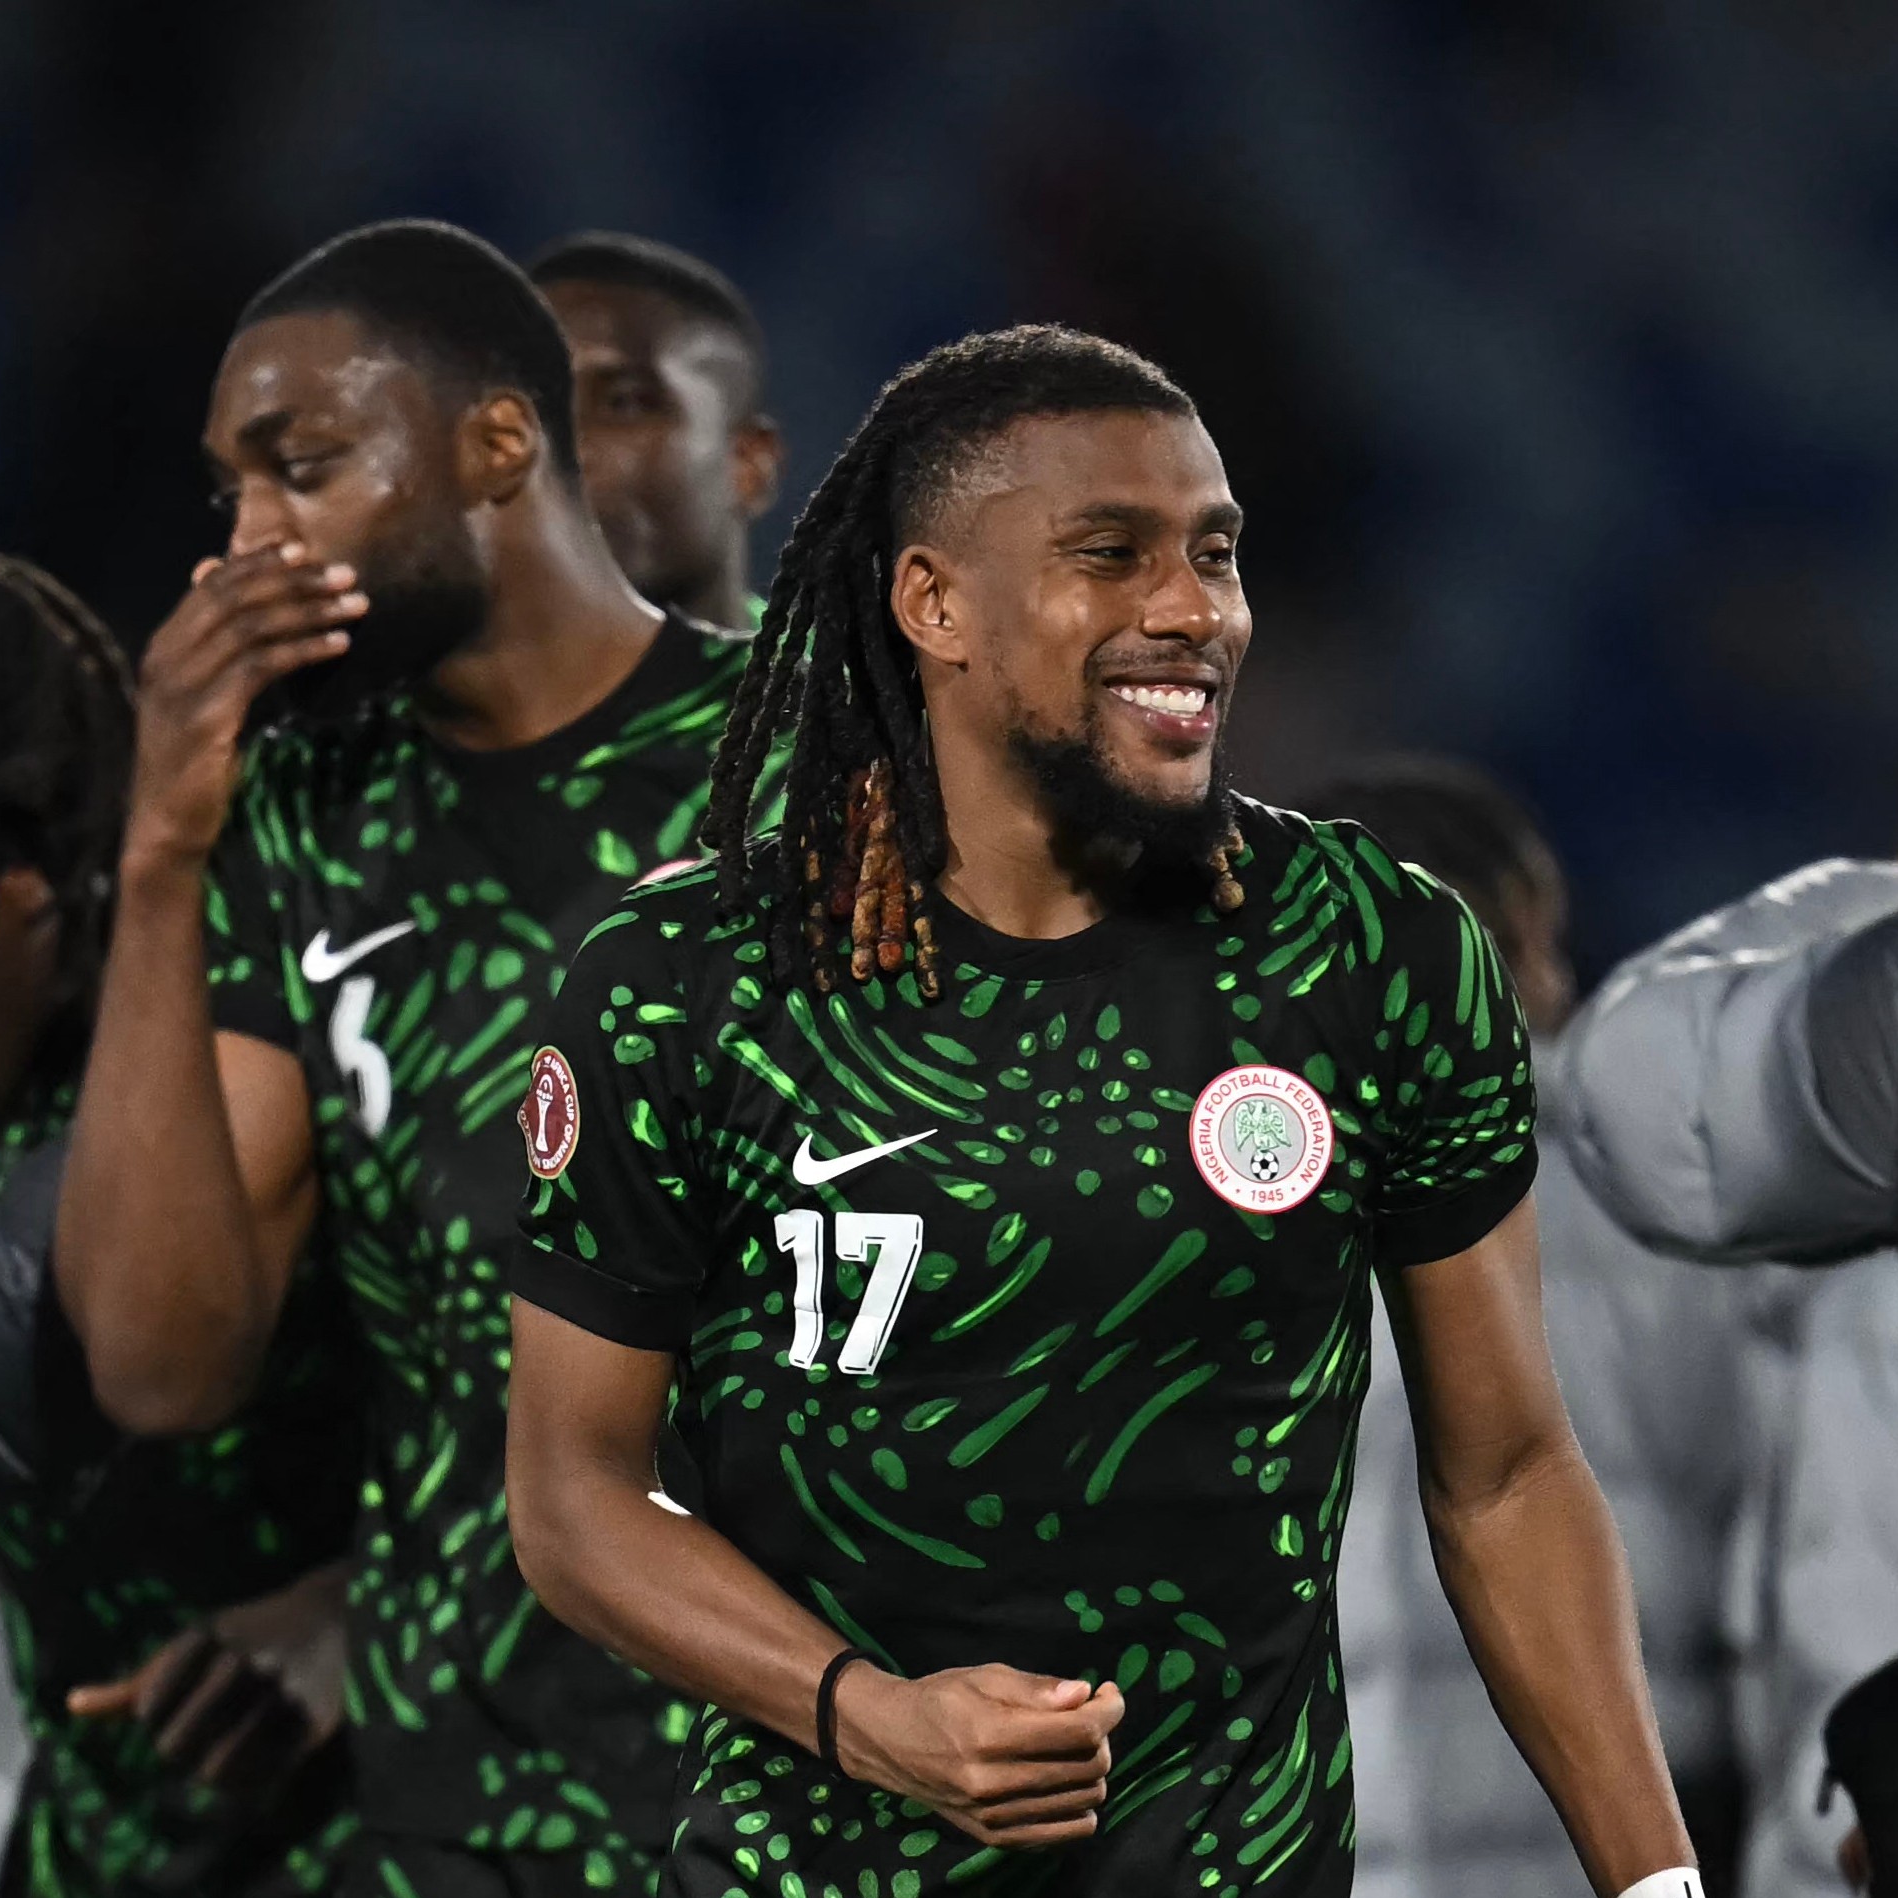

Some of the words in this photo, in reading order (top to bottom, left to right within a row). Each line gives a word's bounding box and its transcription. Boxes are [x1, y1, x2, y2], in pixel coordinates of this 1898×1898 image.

[564, 1094, 575, 1121] CUP
[1204, 1073, 1282, 1115] FOOTBALL
[563, 1123, 574, 1143] OF
[1198, 1117, 1229, 1185] NIGERIA
[1284, 1081, 1326, 1184] FEDERATION
[1250, 1188, 1285, 1204] 1945
[773, 1208, 924, 1377] 17
